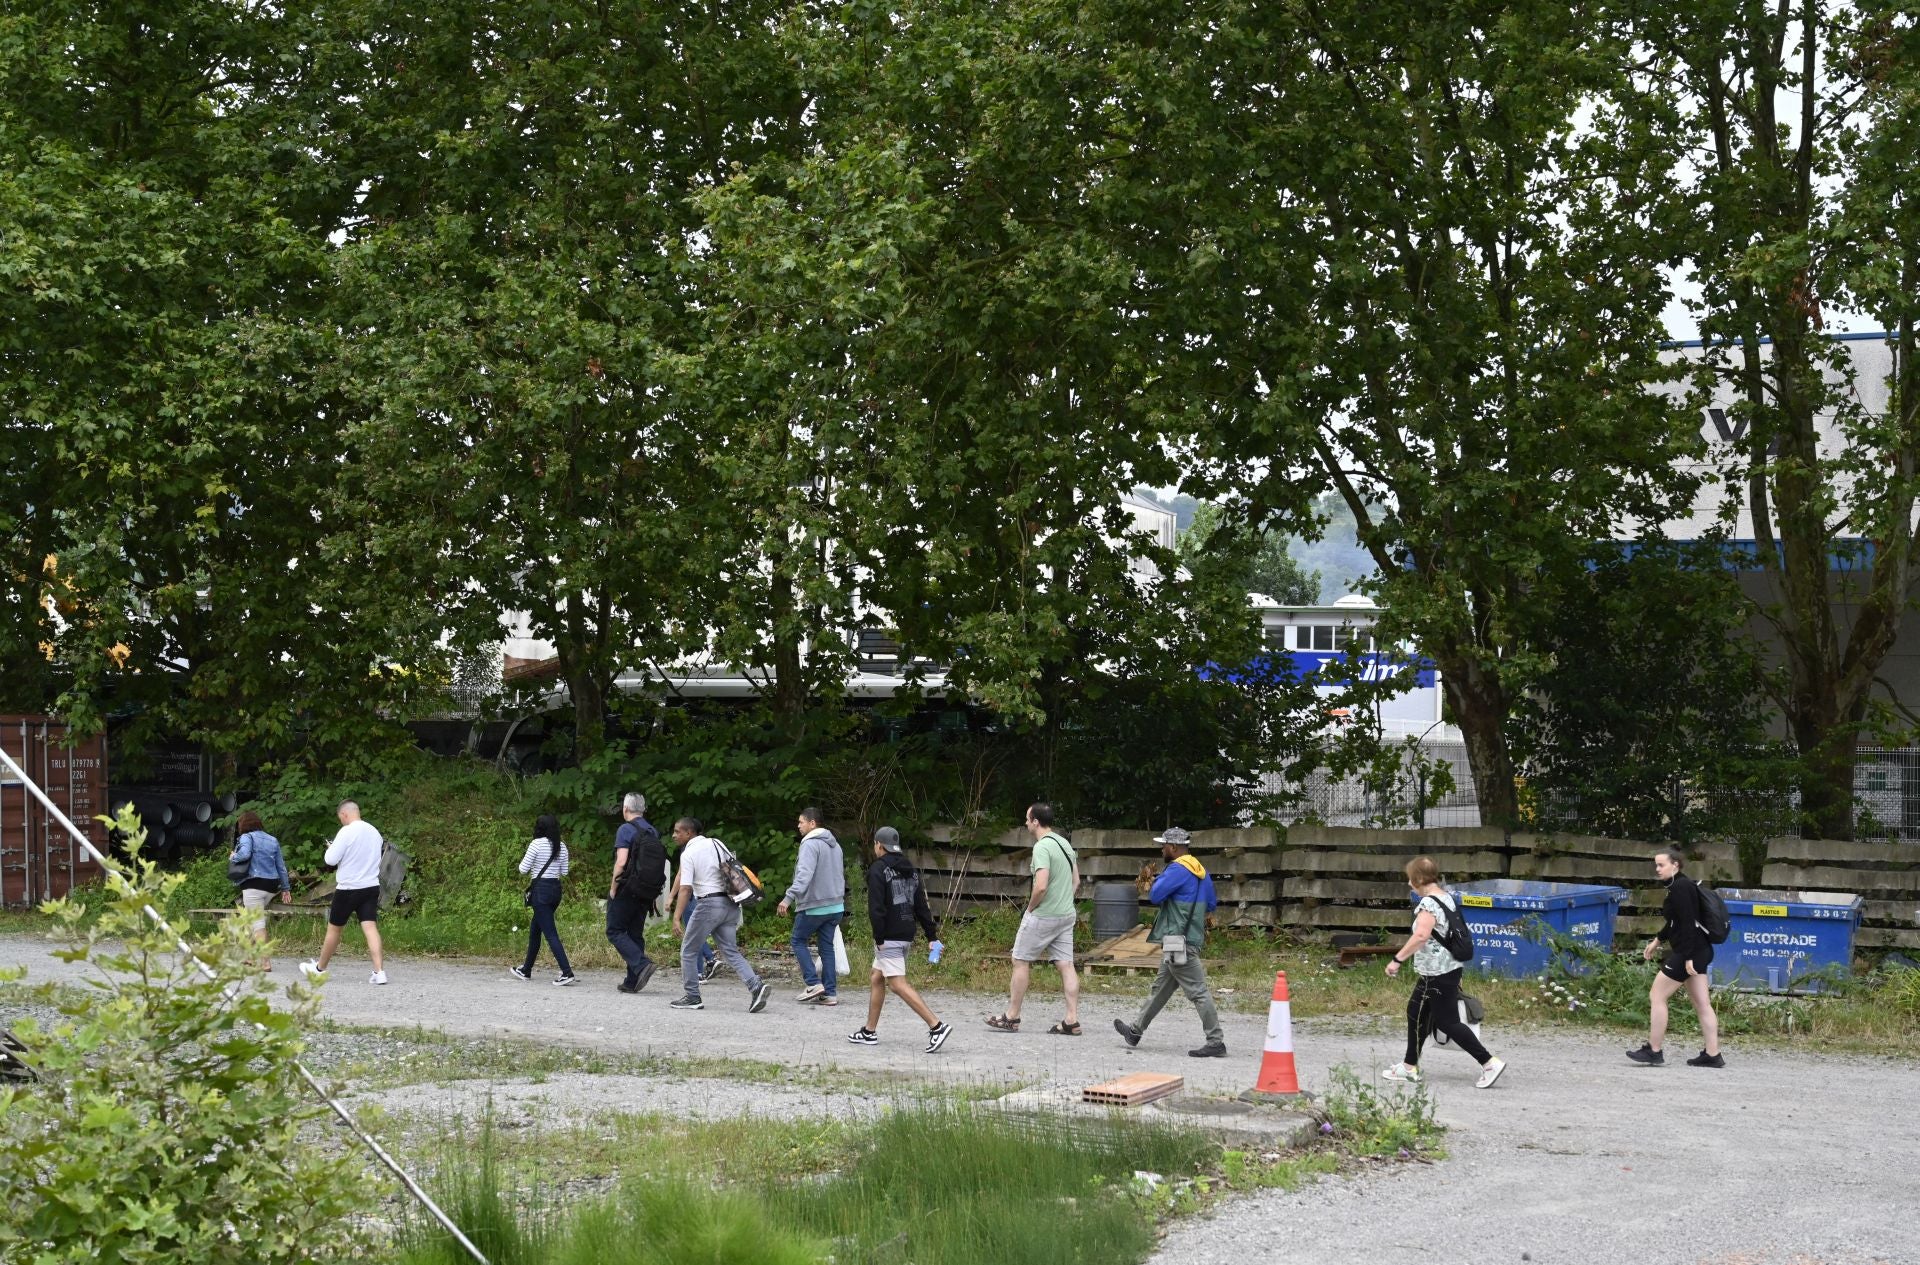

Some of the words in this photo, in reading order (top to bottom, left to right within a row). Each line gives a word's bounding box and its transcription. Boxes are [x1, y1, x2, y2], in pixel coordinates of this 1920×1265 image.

[51, 759, 66, 769] TRLU
[1813, 909, 1848, 919] 2567
[1490, 939, 1501, 948] 20
[1503, 940, 1515, 948] 20
[1744, 932, 1817, 947] EKOTRADE
[1762, 948, 1775, 957] 20
[1777, 949, 1790, 958] 20
[1792, 950, 1806, 959] 20
